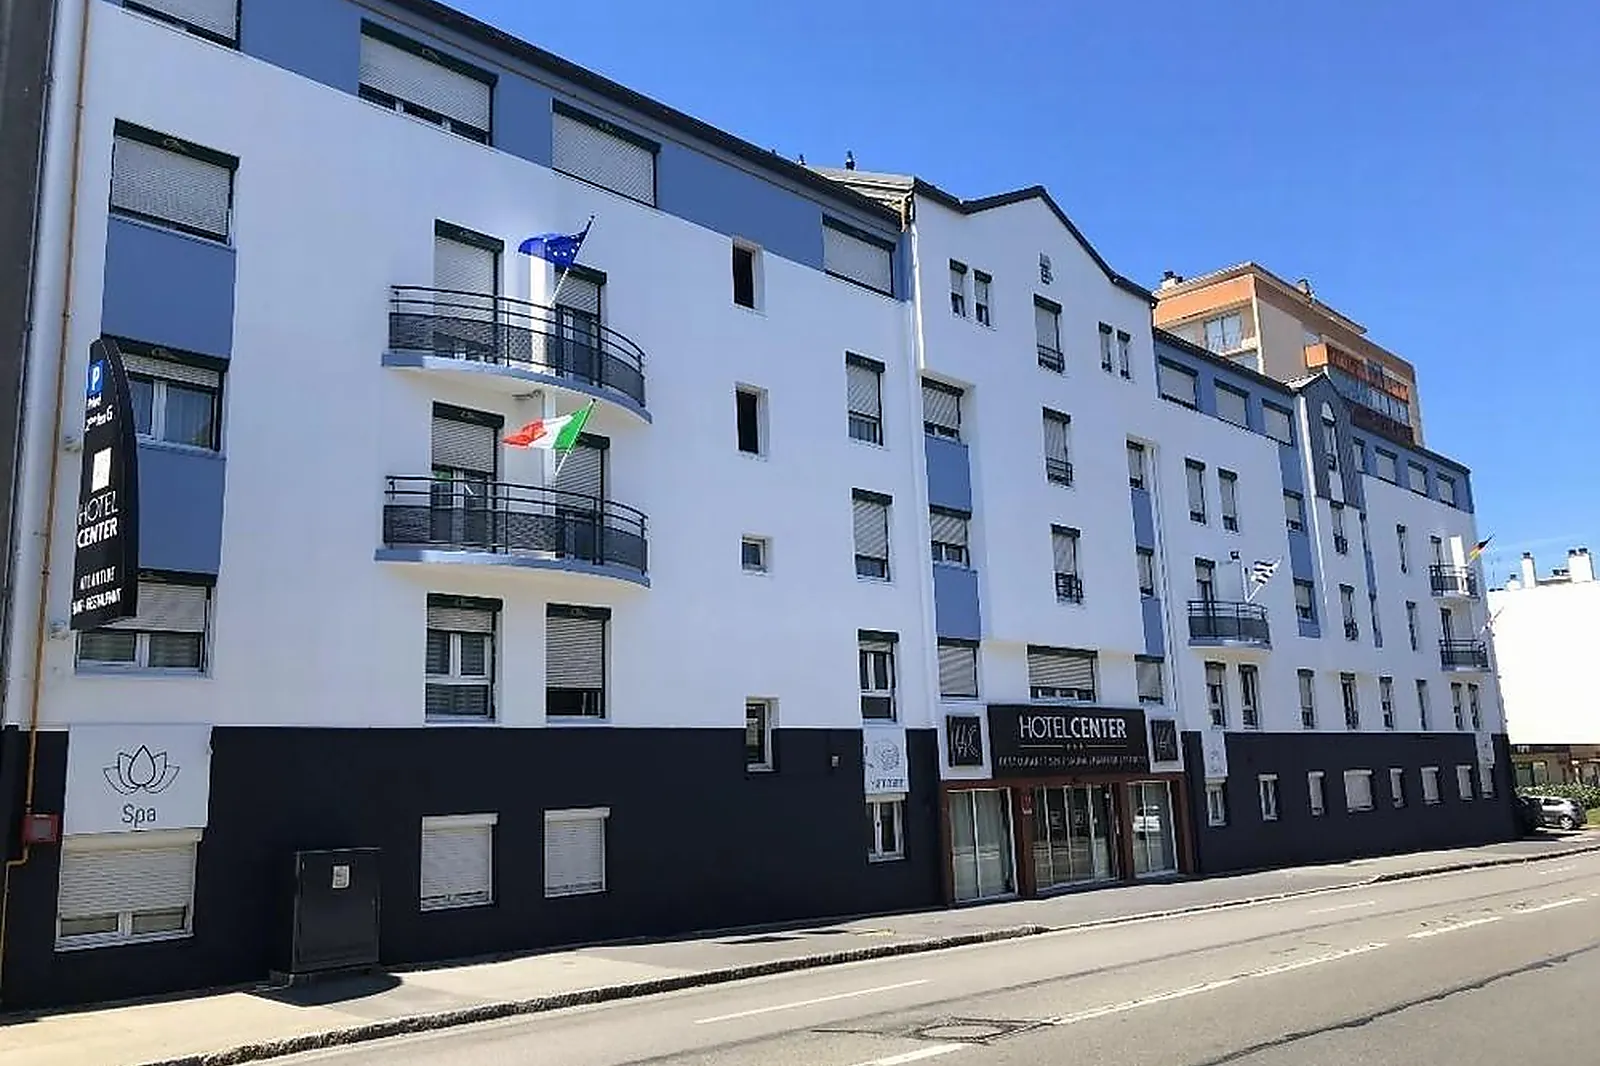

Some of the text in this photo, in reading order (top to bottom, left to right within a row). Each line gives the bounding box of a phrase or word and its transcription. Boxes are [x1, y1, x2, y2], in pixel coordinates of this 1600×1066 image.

[91, 365, 100, 391] P
[78, 490, 119, 525] HOTEL
[77, 516, 118, 549] CENTER
[121, 803, 156, 828] Spa
